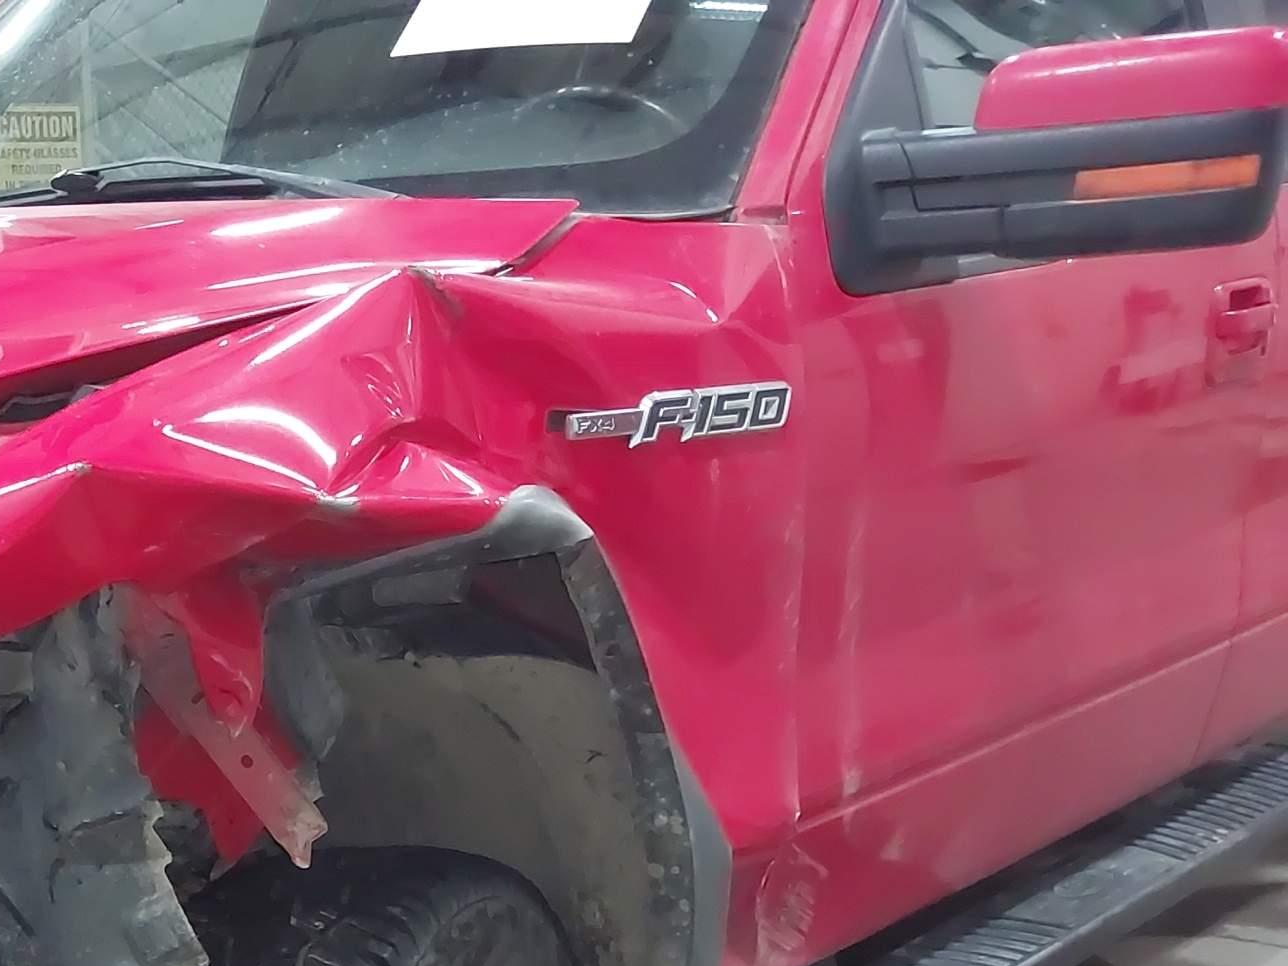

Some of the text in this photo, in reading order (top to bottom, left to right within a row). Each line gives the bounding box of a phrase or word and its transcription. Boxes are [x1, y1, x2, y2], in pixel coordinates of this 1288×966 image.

[33, 146, 79, 160] GLASSES
[11, 163, 63, 175] REQUED
[576, 380, 793, 449] FX4 F-150
